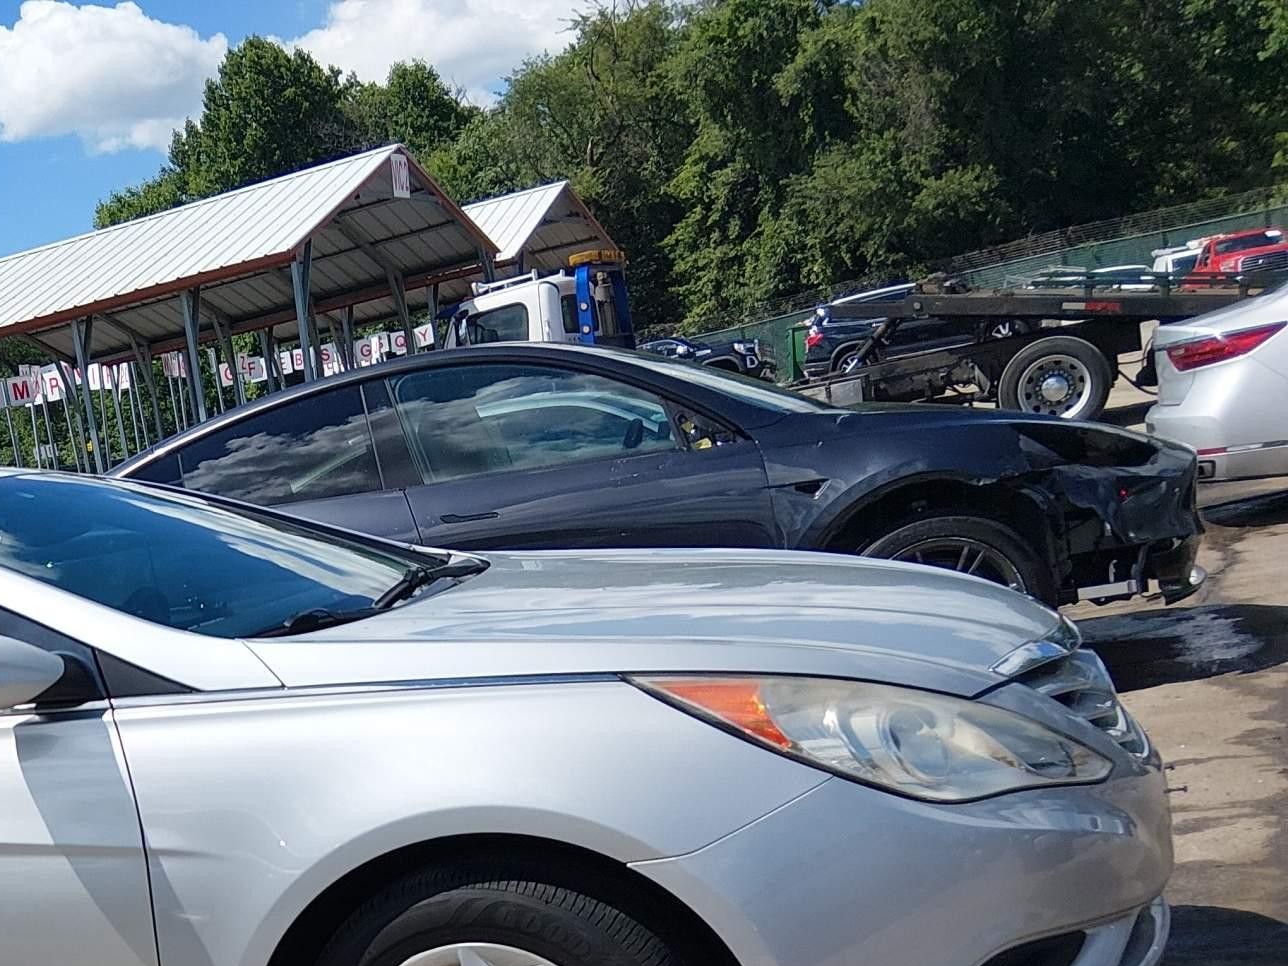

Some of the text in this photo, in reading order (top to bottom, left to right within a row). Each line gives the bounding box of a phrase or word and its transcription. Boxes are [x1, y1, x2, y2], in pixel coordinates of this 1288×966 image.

[395, 334, 408, 348] Q
[418, 328, 429, 342] Y
[320, 348, 330, 362] S
[360, 344, 372, 357] G
[280, 356, 288, 370] E
[295, 353, 303, 366] B
[247, 361, 256, 377] F
[12, 382, 30, 400] M
[49, 377, 59, 395] P
